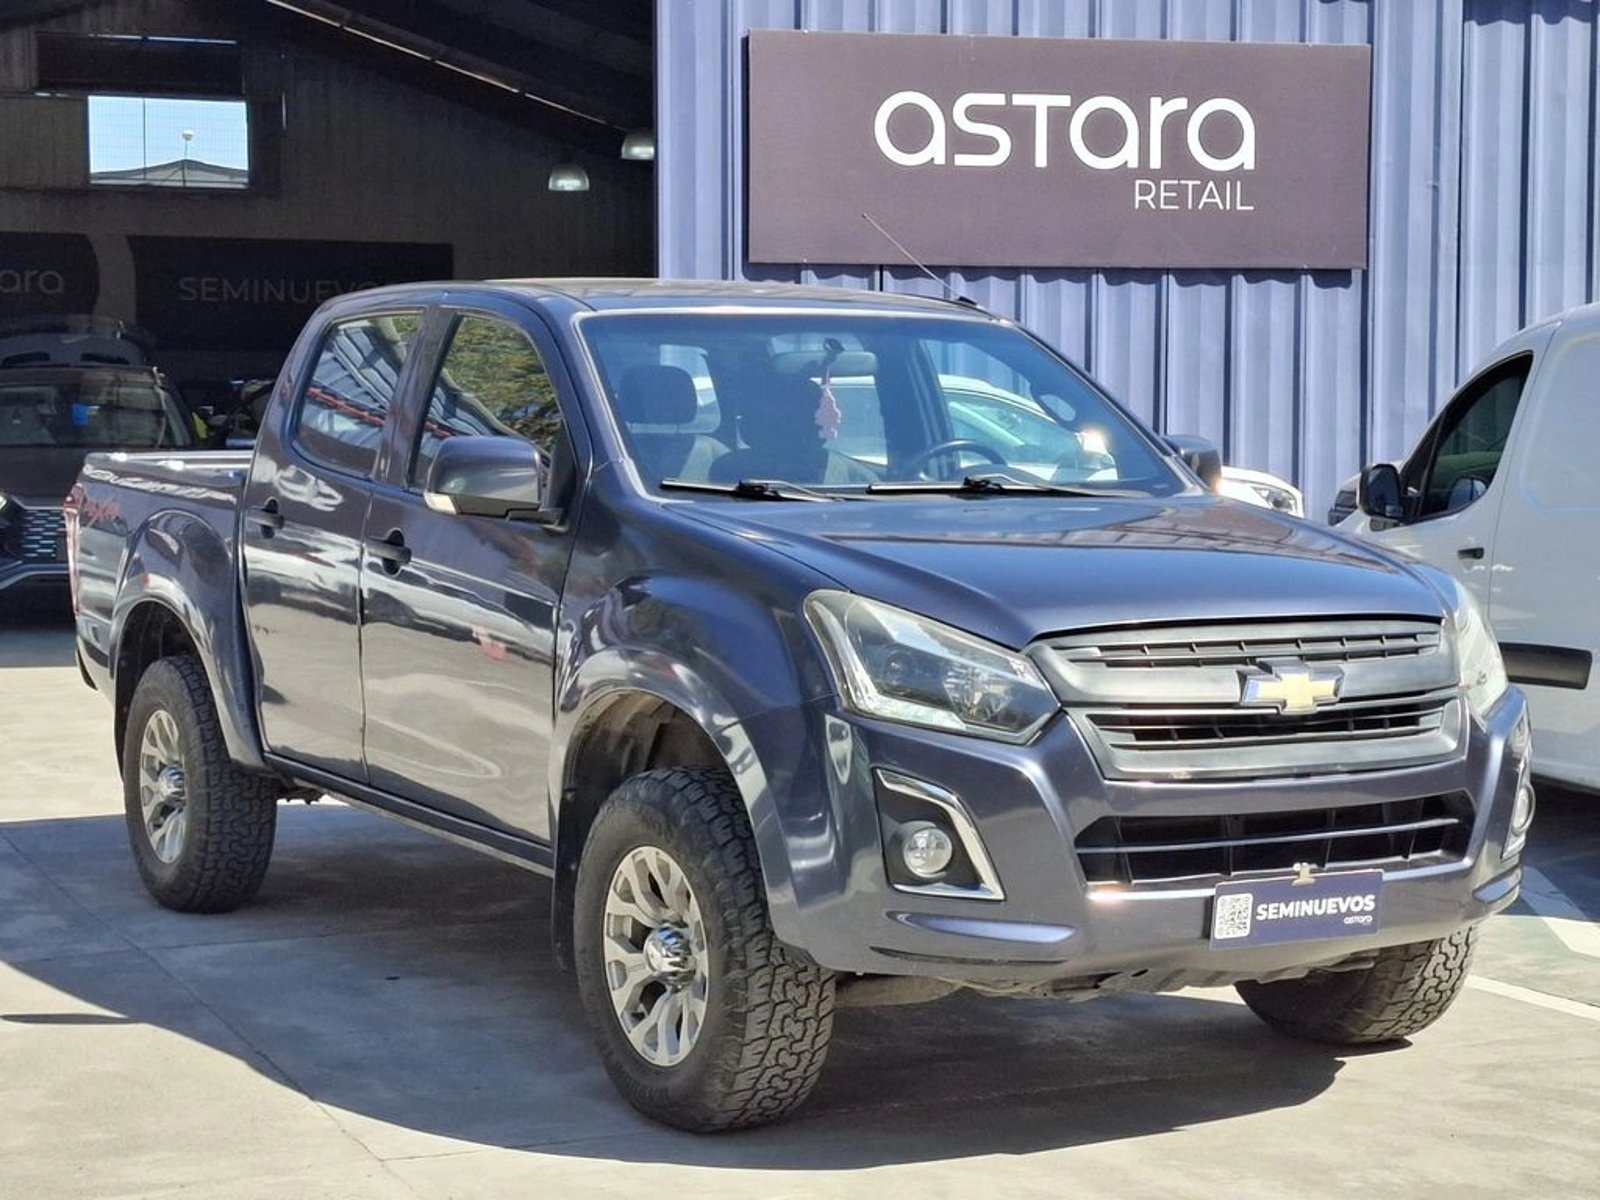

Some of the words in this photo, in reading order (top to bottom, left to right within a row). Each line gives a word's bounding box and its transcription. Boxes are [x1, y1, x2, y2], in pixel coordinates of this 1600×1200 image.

[1134, 179, 1255, 211] RETAIL
[0, 267, 64, 295] ara
[1255, 894, 1376, 921] SEMINUEVOS
